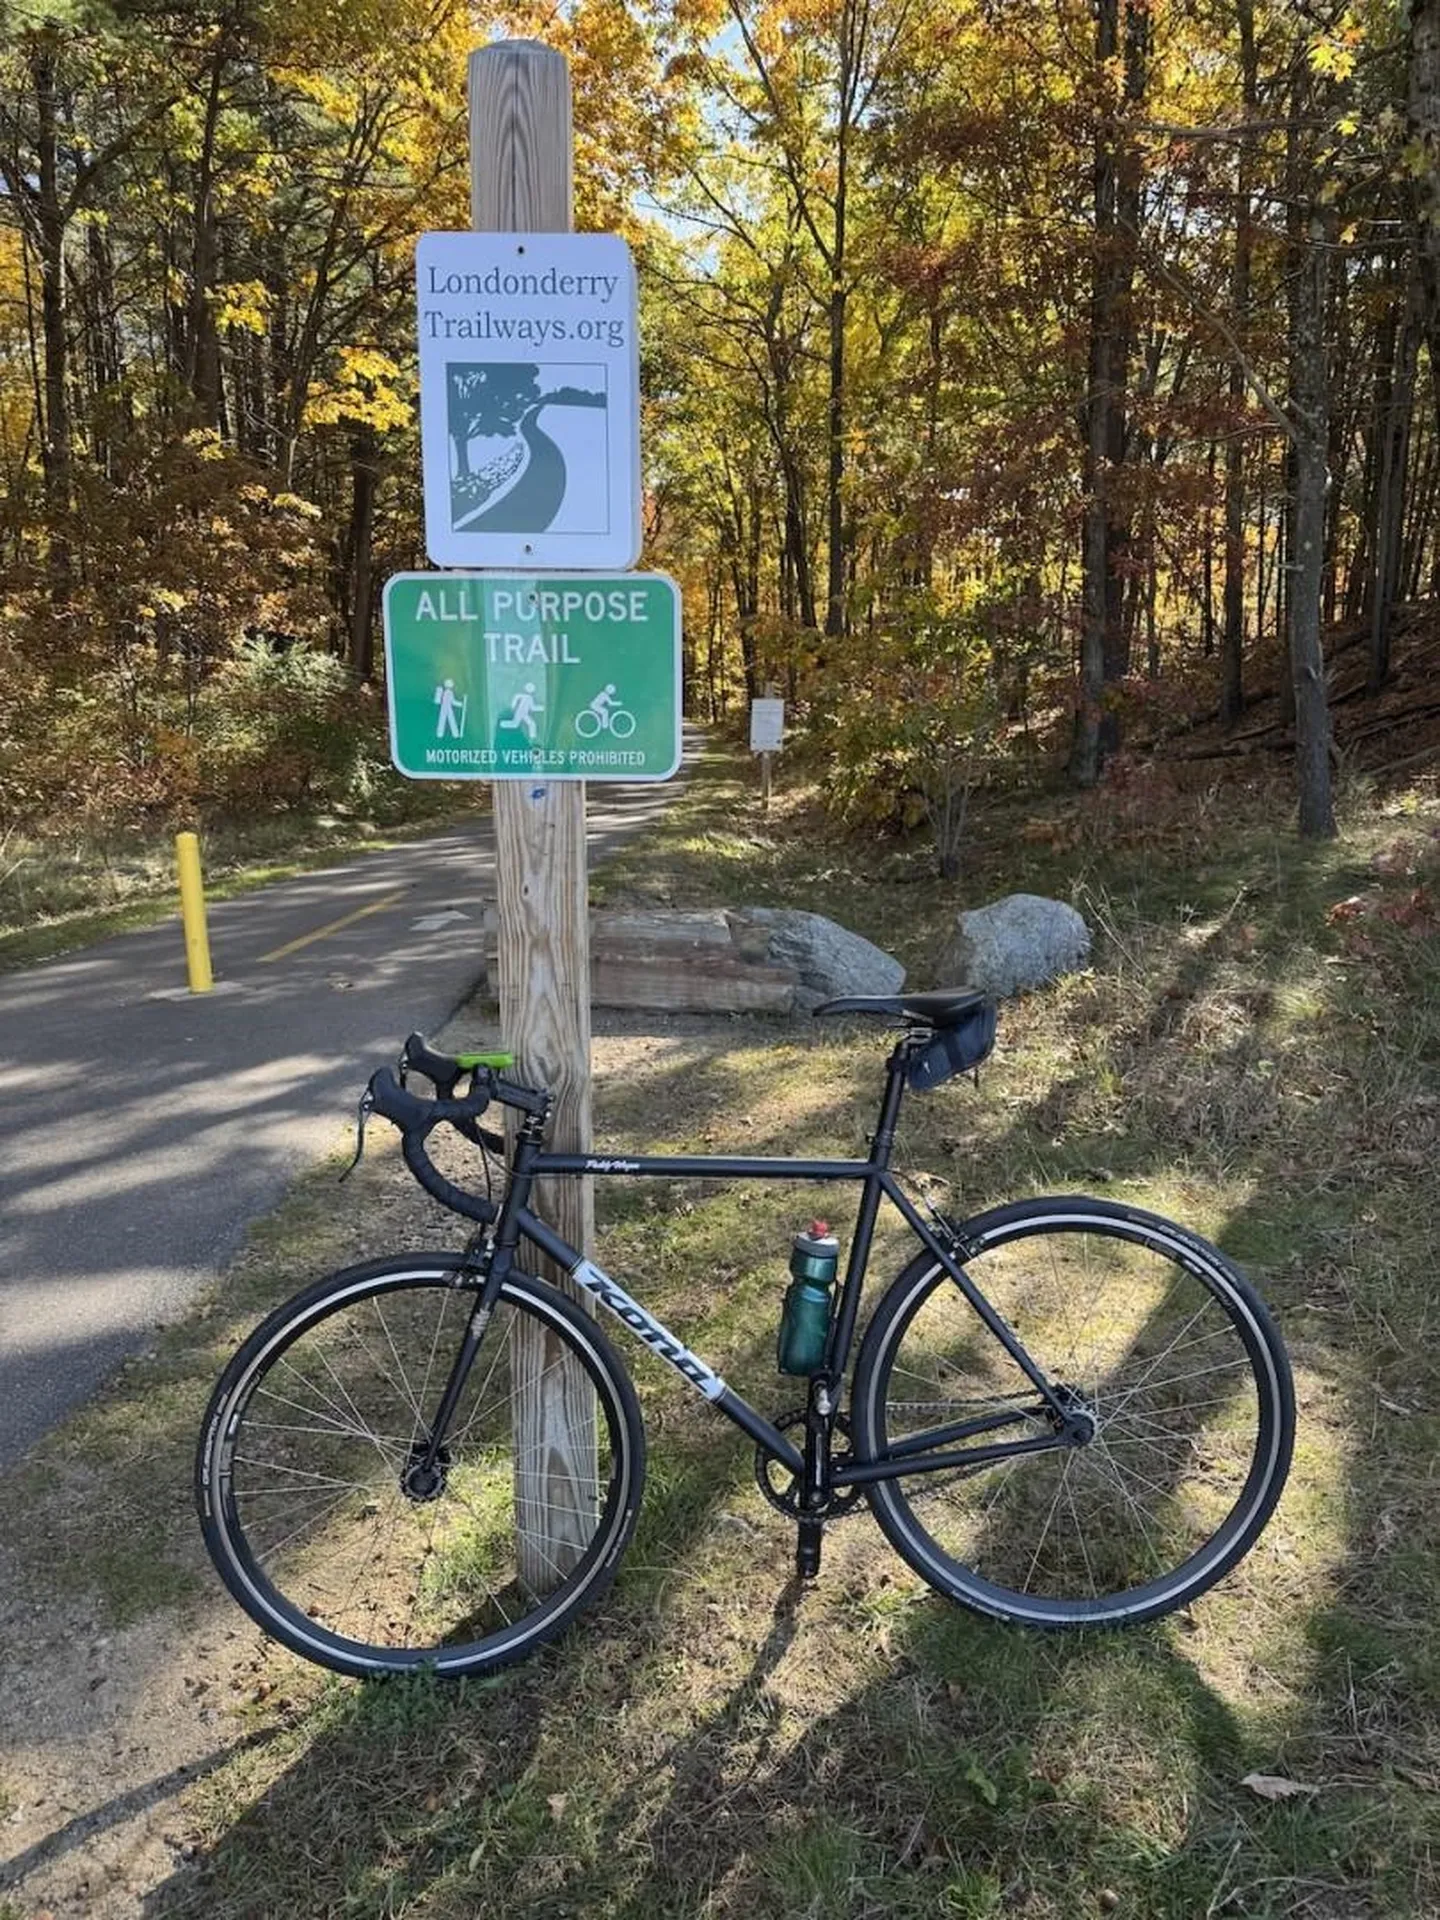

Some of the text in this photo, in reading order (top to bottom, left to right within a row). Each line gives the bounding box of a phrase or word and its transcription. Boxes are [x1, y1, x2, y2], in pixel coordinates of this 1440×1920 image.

[427, 266, 618, 304] Londonderry
[424, 311, 624, 348] Trailways.org
[416, 590, 649, 623] ALL PURPOSE
[483, 632, 581, 664] TRAIL
[426, 749, 496, 764] MOTORIZED
[570, 750, 645, 767] PROHIBITED
